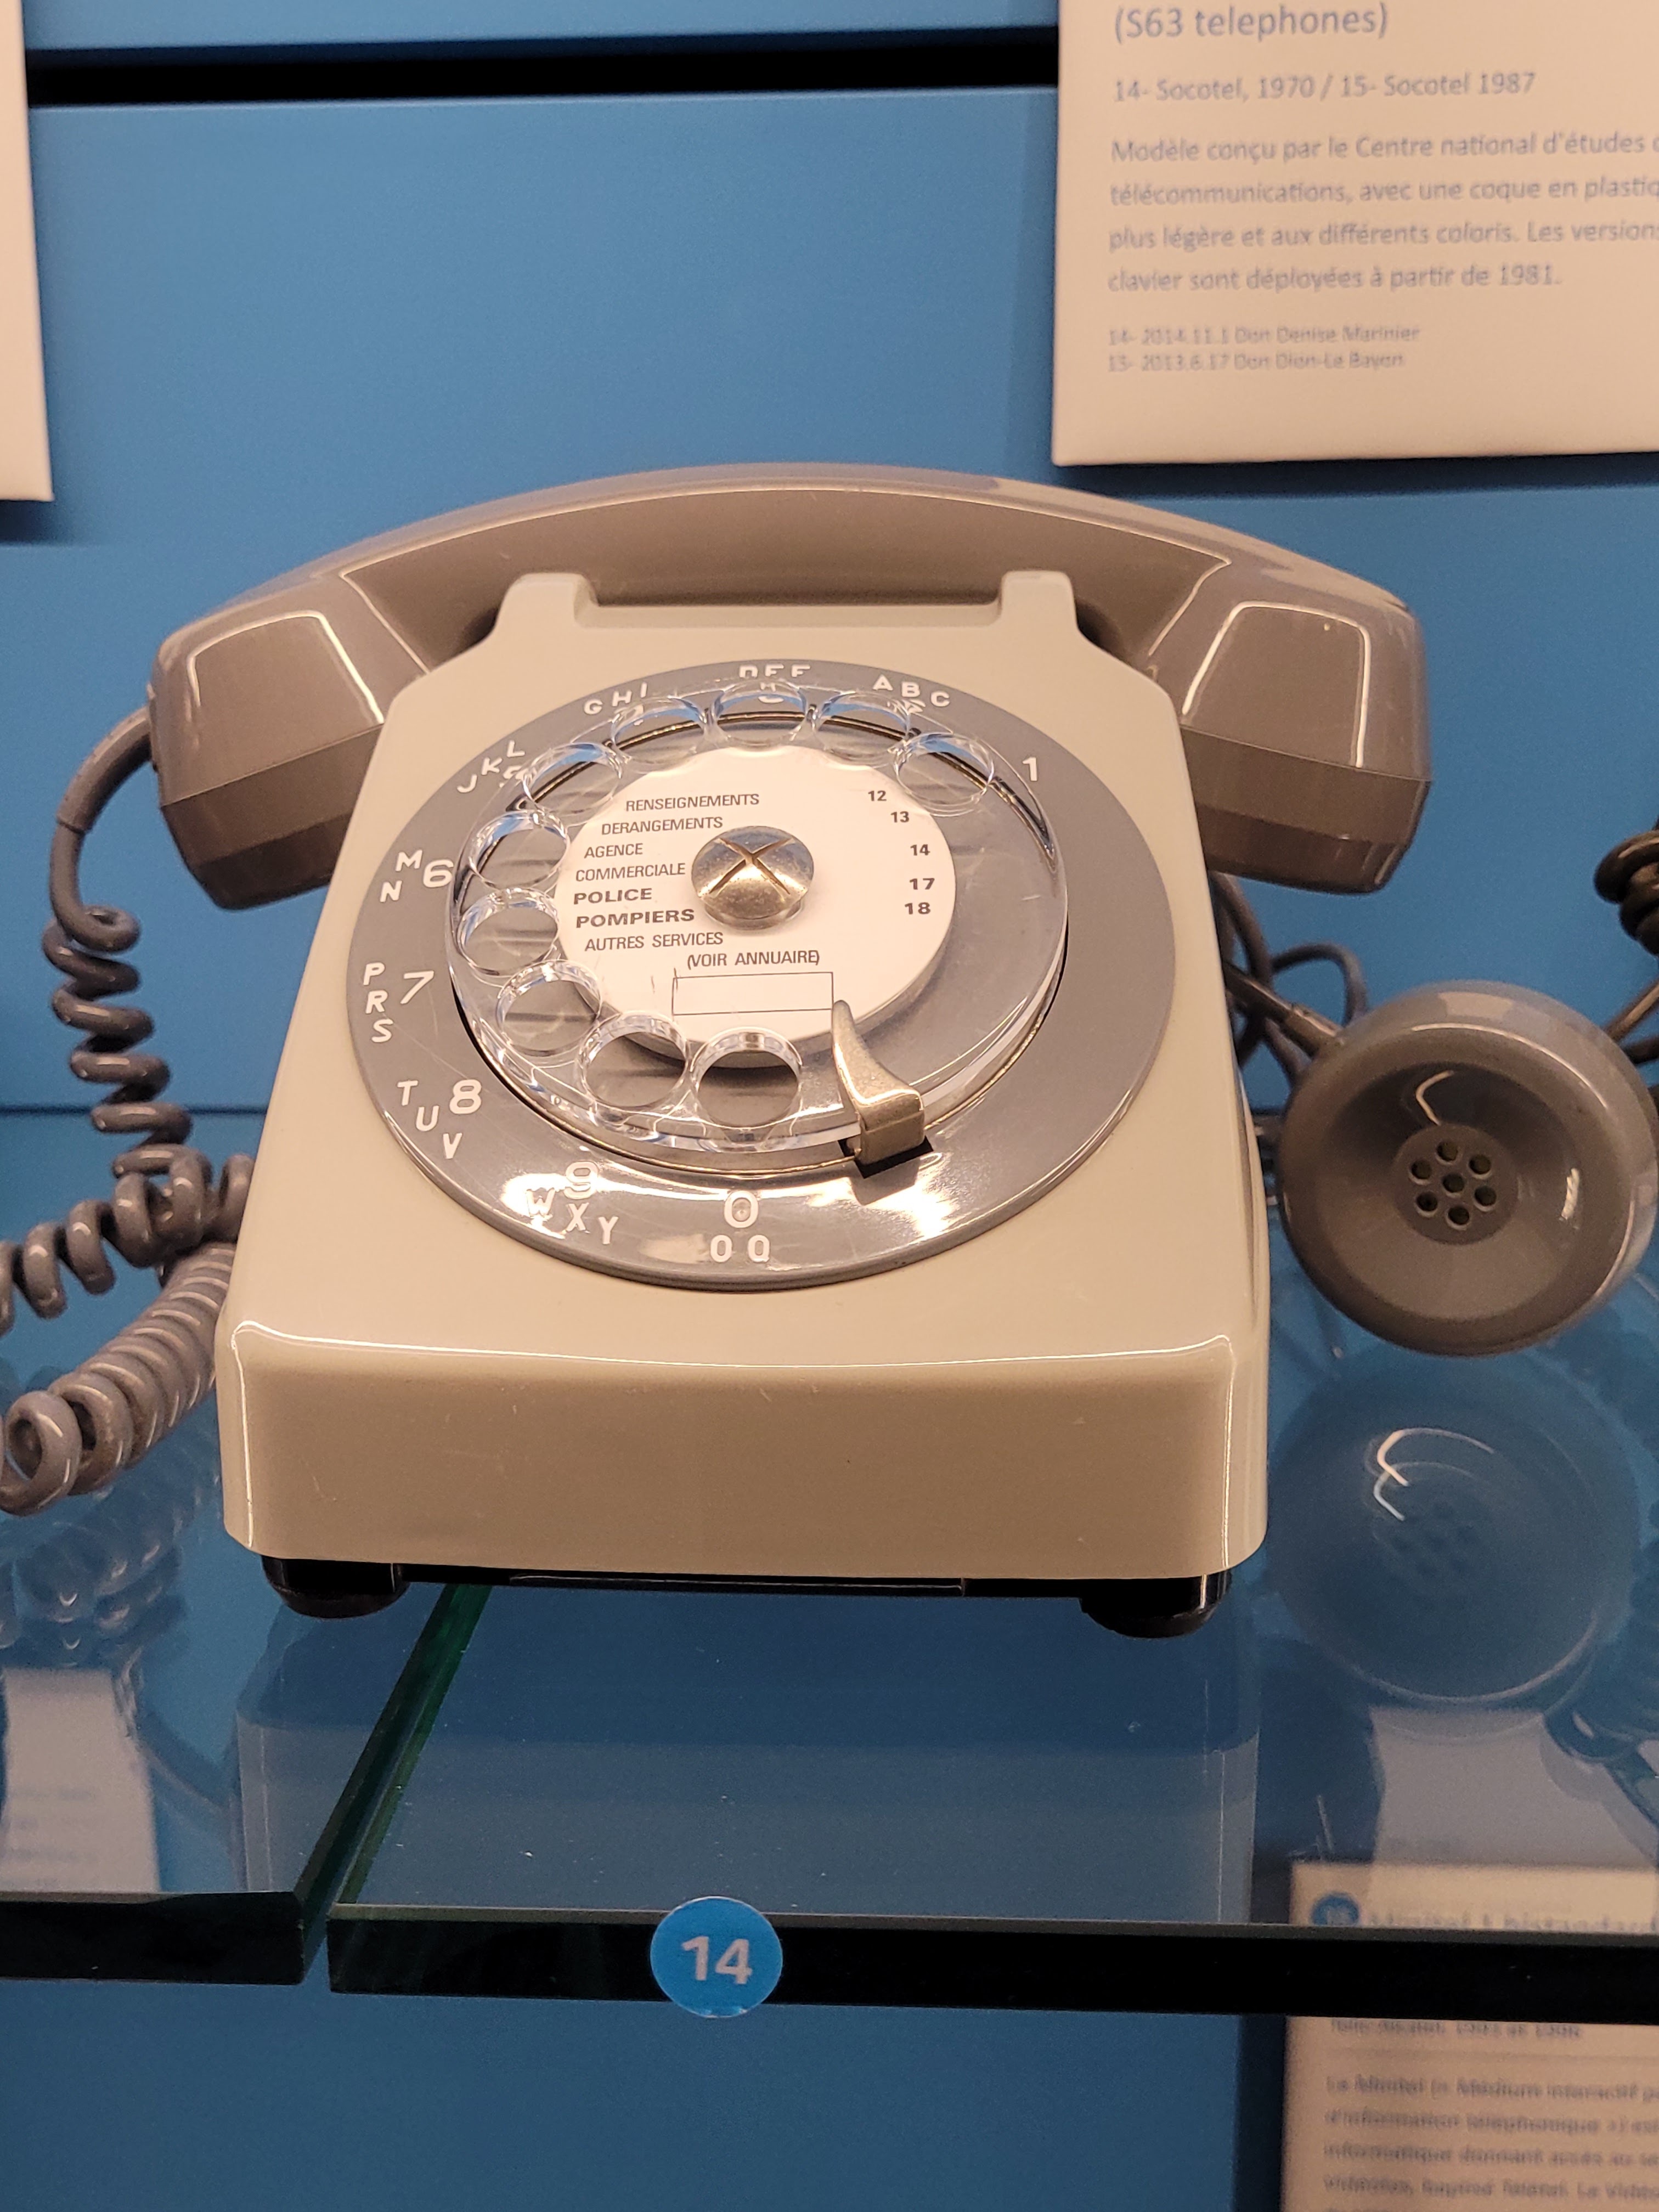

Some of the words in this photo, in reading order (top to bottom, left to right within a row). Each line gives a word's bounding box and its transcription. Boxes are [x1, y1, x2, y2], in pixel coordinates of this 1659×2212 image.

[1115, 7, 1183, 44] (S63
[1194, 1, 1389, 43] telephones)
[1114, 79, 1149, 102] 14-
[1156, 77, 1250, 103] Socotel,
[1258, 75, 1316, 99] 1970
[1319, 73, 1334, 101] /
[1341, 74, 1376, 98] 15-
[1384, 71, 1471, 97] Socotel
[1478, 71, 1537, 95] 1987
[1111, 136, 1200, 162] Modèle
[1206, 142, 1277, 165] conçu
[1283, 141, 1322, 163] par
[1328, 135, 1348, 159] le
[1355, 135, 1434, 159] Centre
[1441, 131, 1537, 156] national
[1542, 131, 1646, 155] d'études
[1110, 180, 1354, 206] télécommunications,
[1359, 183, 1413, 202] avec
[1419, 183, 1463, 200] une
[1469, 182, 1541, 203] coque
[1548, 181, 1578, 199] en
[1109, 225, 1156, 253] plus
[1163, 225, 1235, 253] légère
[1241, 227, 1265, 247] et
[1271, 229, 1313, 246] aux
[1318, 221, 1430, 246] différents
[1436, 221, 1520, 244] coloris.
[1527, 221, 1565, 242] Les
[1107, 268, 1183, 292] clavier
[1189, 269, 1240, 291] sont
[1246, 266, 1364, 294] déployées
[1369, 265, 1384, 287] à
[1390, 266, 1456, 291] partir
[1460, 263, 1490, 287] de
[1499, 263, 1561, 286] 1981.
[1022, 757, 1038, 782] 1
[625, 793, 760, 812] RENSEIGNEMENTS
[868, 790, 887, 802] 12
[601, 816, 724, 836] DERANGEMENTS
[890, 811, 910, 823] 13
[583, 842, 644, 859] AGENCE
[910, 844, 931, 856] 14
[422, 859, 455, 888] 6
[575, 862, 686, 882] COMMERCIALE
[909, 877, 935, 890] 17
[573, 887, 653, 905] POLICE
[575, 908, 695, 929] POMPIERS
[905, 902, 932, 915] 18
[584, 935, 645, 952] AUTRES
[651, 931, 724, 949] SERVICES
[686, 952, 728, 970] (VOIR
[733, 949, 821, 967] ANNUAIRE)
[400, 970, 435, 1005] 7
[449, 1079, 482, 1115] 8
[563, 1161, 600, 1200] 9
[681, 1935, 753, 1985] 14
